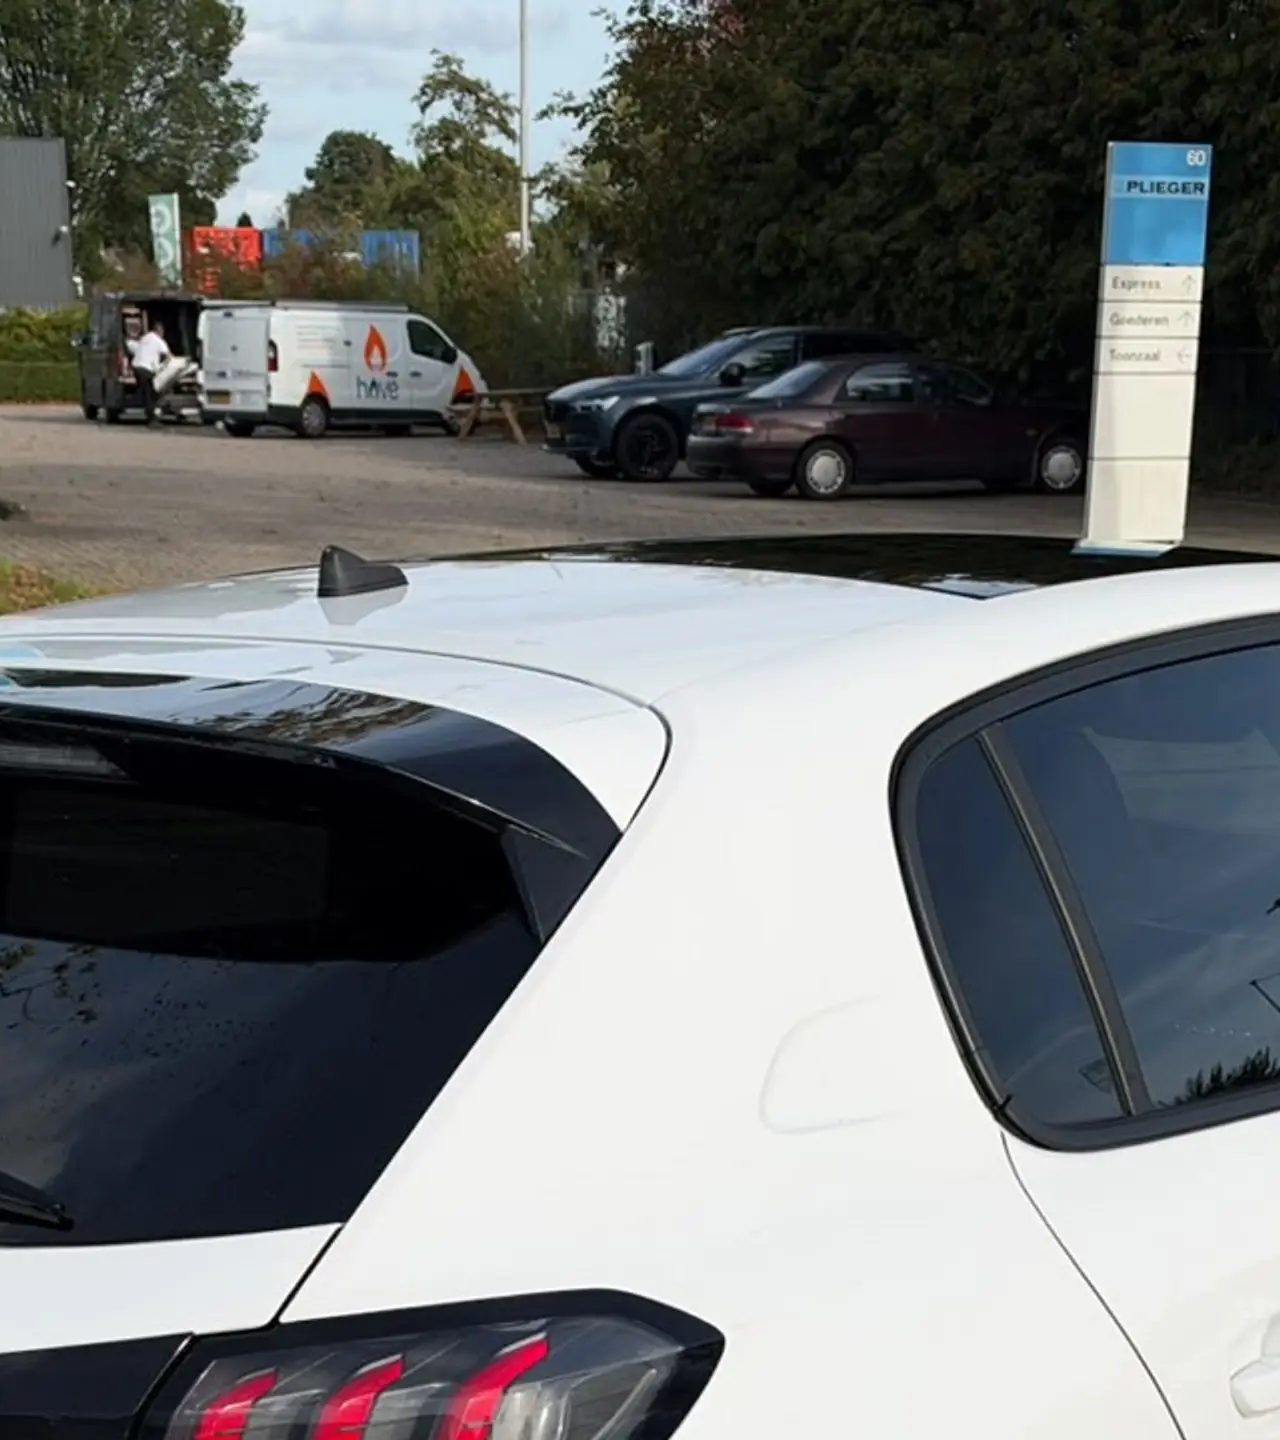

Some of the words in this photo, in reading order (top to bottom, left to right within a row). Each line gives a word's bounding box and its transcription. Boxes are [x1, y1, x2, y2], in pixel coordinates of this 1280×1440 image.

[1186, 150, 1207, 167] 60
[1125, 181, 1206, 195] PLIEGER
[1111, 275, 1161, 292] Express
[1109, 312, 1170, 328] Goederen
